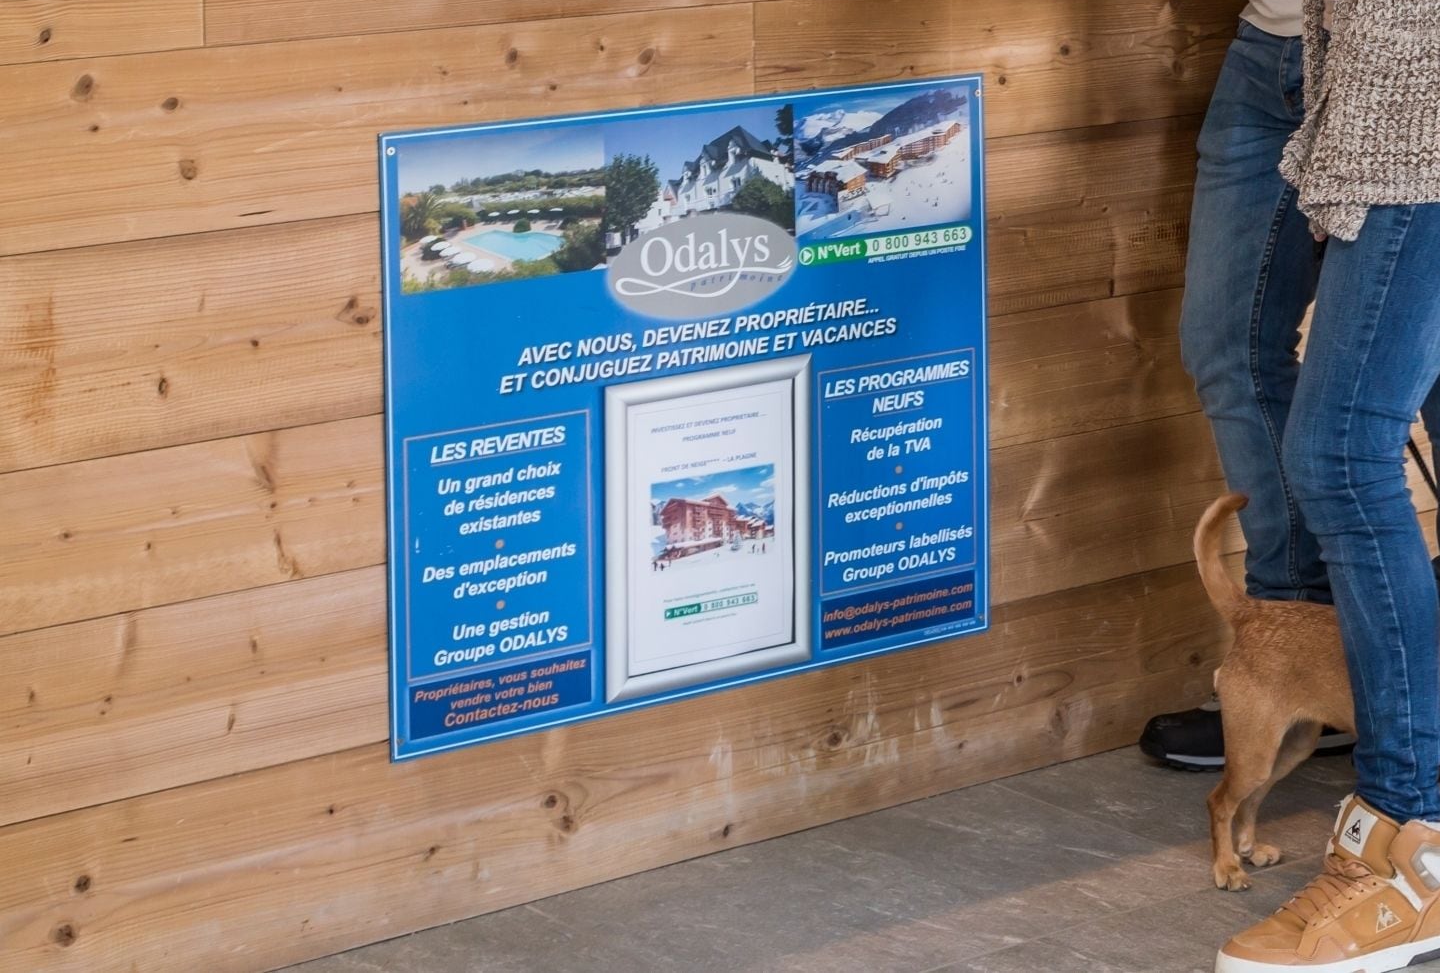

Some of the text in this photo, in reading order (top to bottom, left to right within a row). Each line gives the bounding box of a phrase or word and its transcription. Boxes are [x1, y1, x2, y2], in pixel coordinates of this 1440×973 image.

[817, 228, 967, 260] N°Vert 0 800 943 663
[640, 228, 770, 297] Odalys
[690, 273, 783, 292] patrimoine
[518, 298, 880, 366] AVEC NOUS, DEVENEZ PROPRIÉTAIRE...
[500, 317, 897, 394] ET CONJUGUEZ PATRIMOINE ET VACANCES
[825, 360, 970, 398] LES PROGRAMMES
[872, 390, 925, 414] NEUFS
[430, 426, 566, 464] LES REVENTES
[851, 417, 943, 444] Récupération
[866, 437, 931, 461] de la TVA
[438, 461, 562, 495] Un grand choix
[828, 470, 969, 508] Réductions d'impôts
[444, 485, 555, 516] de résidences
[845, 492, 953, 523] exceptionnelles
[459, 509, 541, 535] existantes
[422, 542, 576, 583] Des emplacements
[824, 524, 973, 566] Promoteurs labellisés
[843, 547, 956, 583] Groupe ODALYS
[453, 570, 548, 599] d'exception
[823, 582, 974, 623] info@odalys-patrimoine.com
[825, 599, 972, 639] www.odalys-patrimoine.com
[453, 611, 550, 640] Une gestion
[434, 625, 569, 666] Groupe ODALYS
[414, 657, 586, 703] Propriétaires, vous souhaitez
[451, 680, 553, 710] vendre votre bien
[444, 693, 560, 727] Contactez-nous
